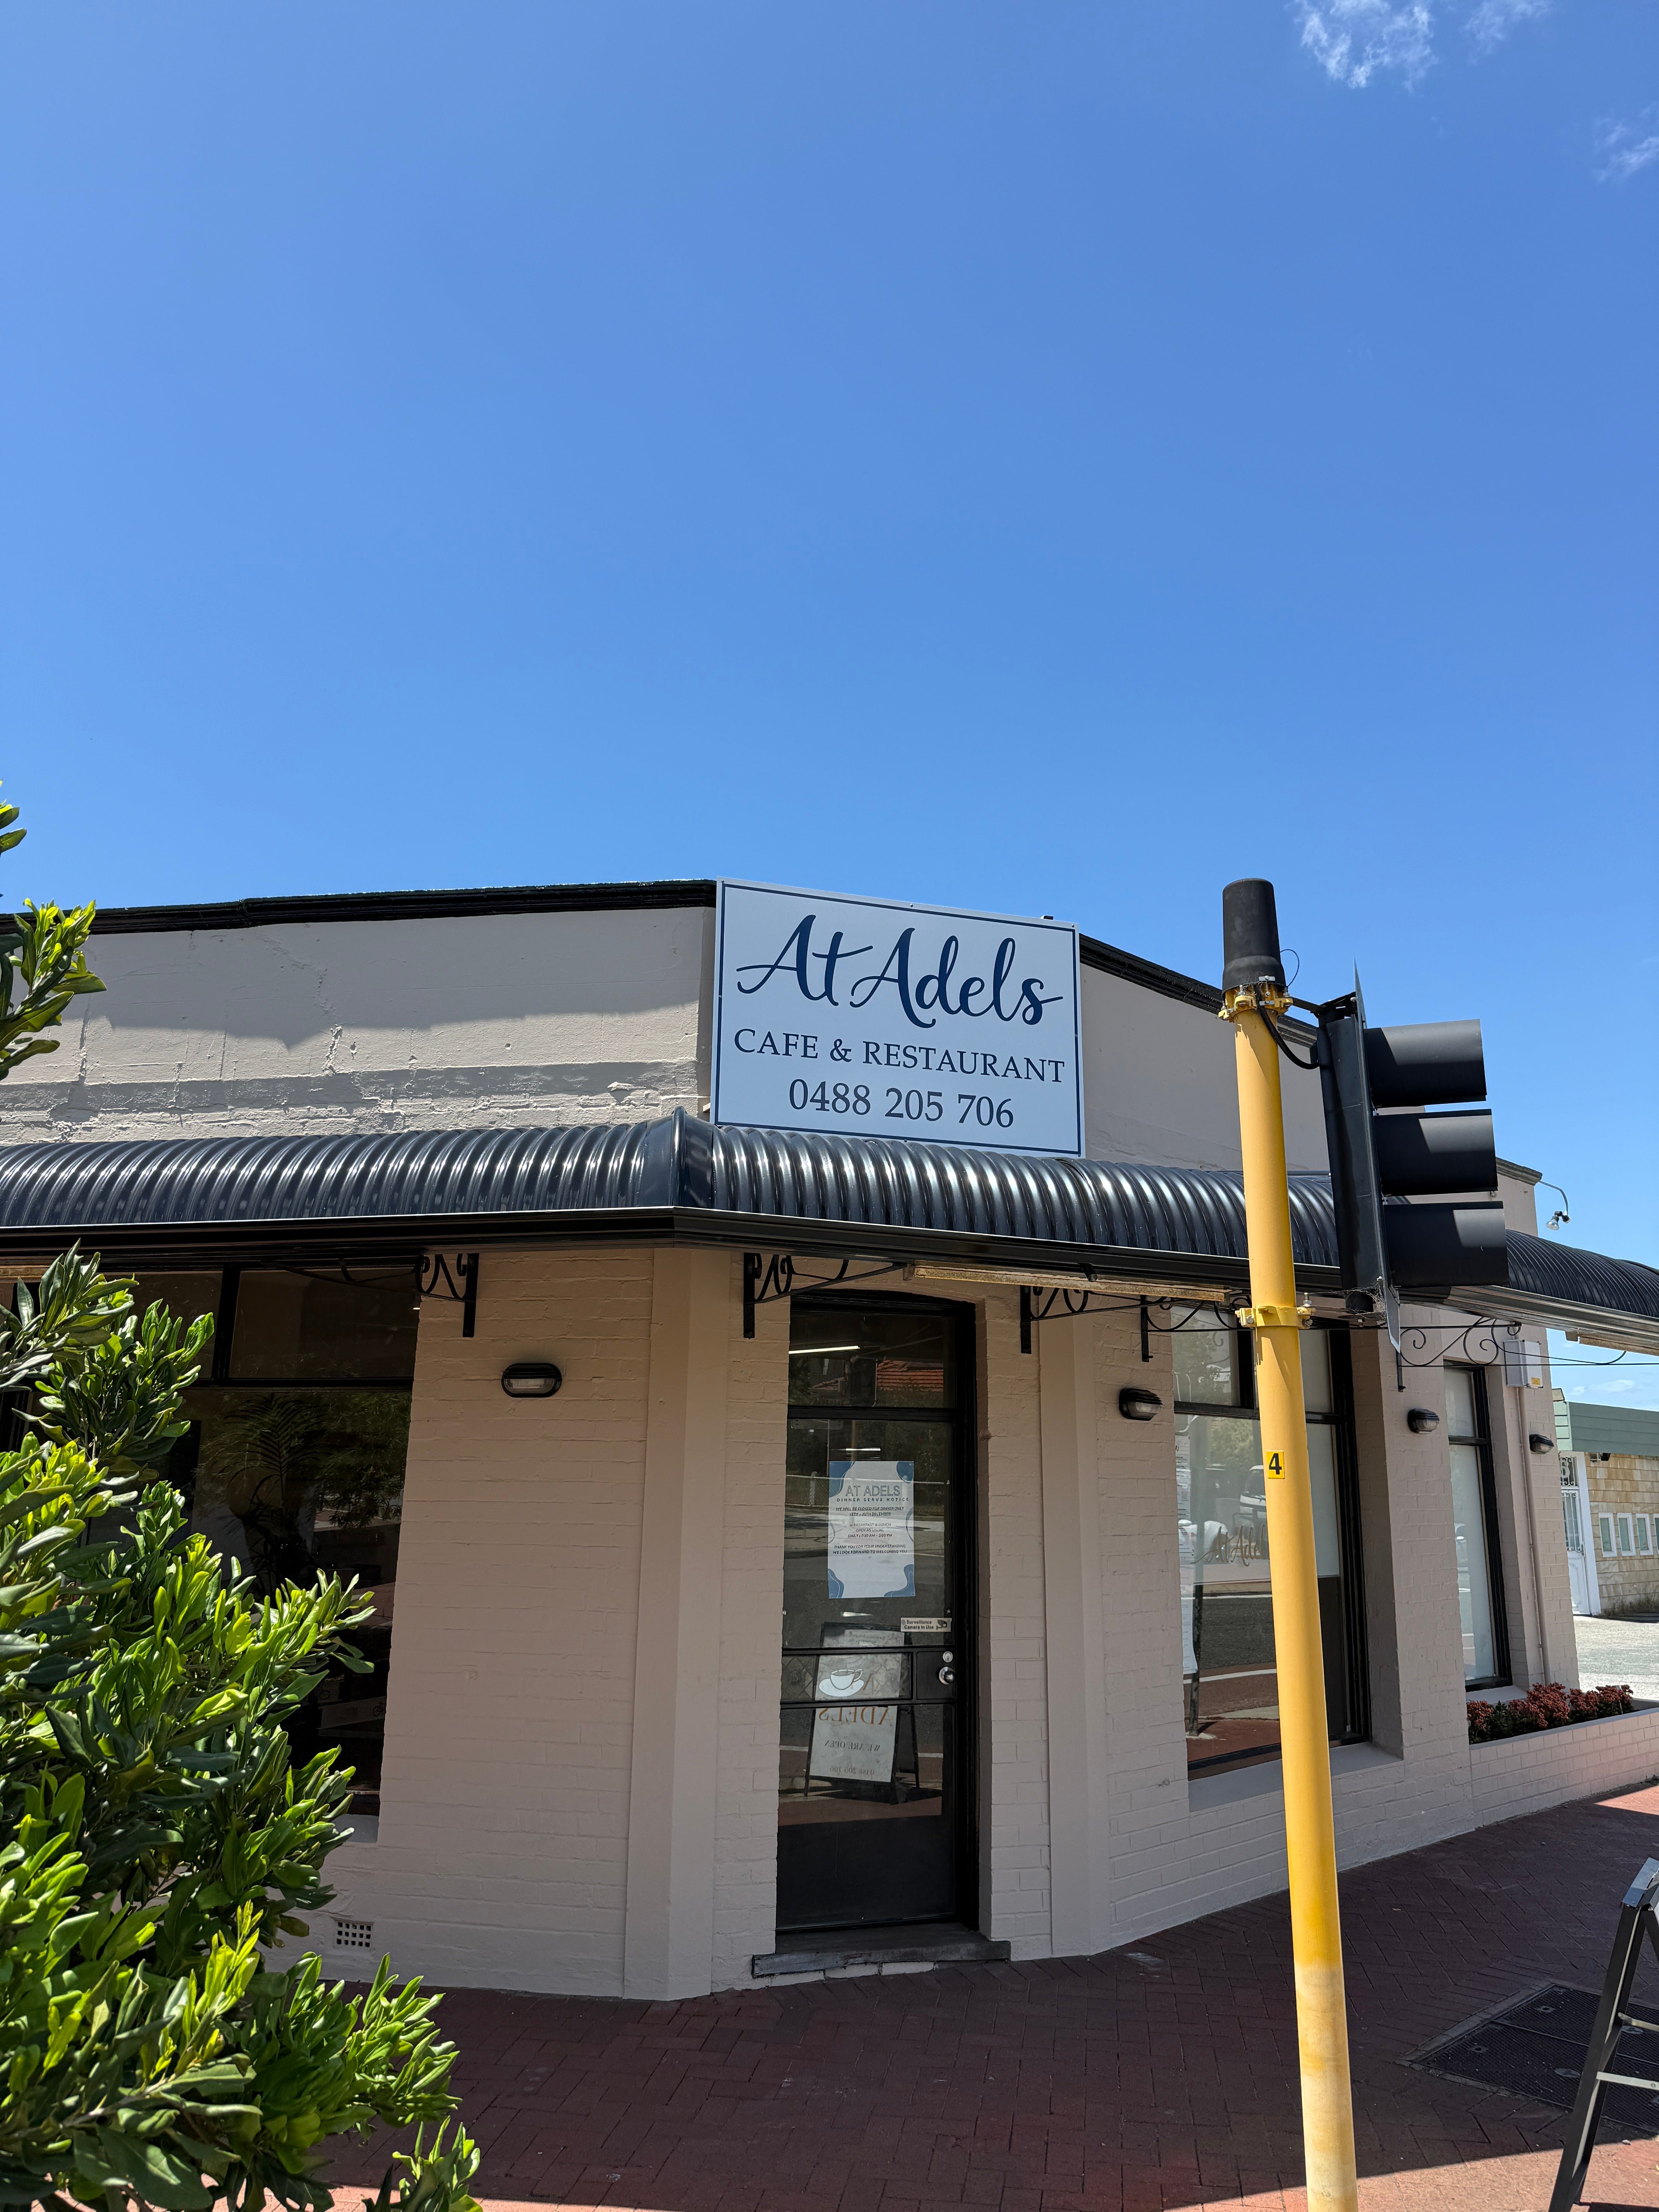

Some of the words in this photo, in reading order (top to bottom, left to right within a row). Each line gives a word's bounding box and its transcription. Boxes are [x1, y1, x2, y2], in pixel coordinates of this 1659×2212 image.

[736, 915, 873, 1006] At
[850, 928, 1063, 1028] Adels
[735, 1029, 818, 1058] CAFE
[830, 1039, 852, 1062] &
[863, 1041, 1064, 1082] RESTAURANT
[790, 1079, 870, 1115] 0488
[885, 1088, 943, 1121] 205
[958, 1094, 1013, 1127] 706
[1269, 1453, 1282, 1475] 4
[845, 1486, 861, 1496] AT
[864, 1486, 900, 1496] ADELS
[1190, 1526, 1235, 1563] At
[1230, 1524, 1268, 1566] Adel
